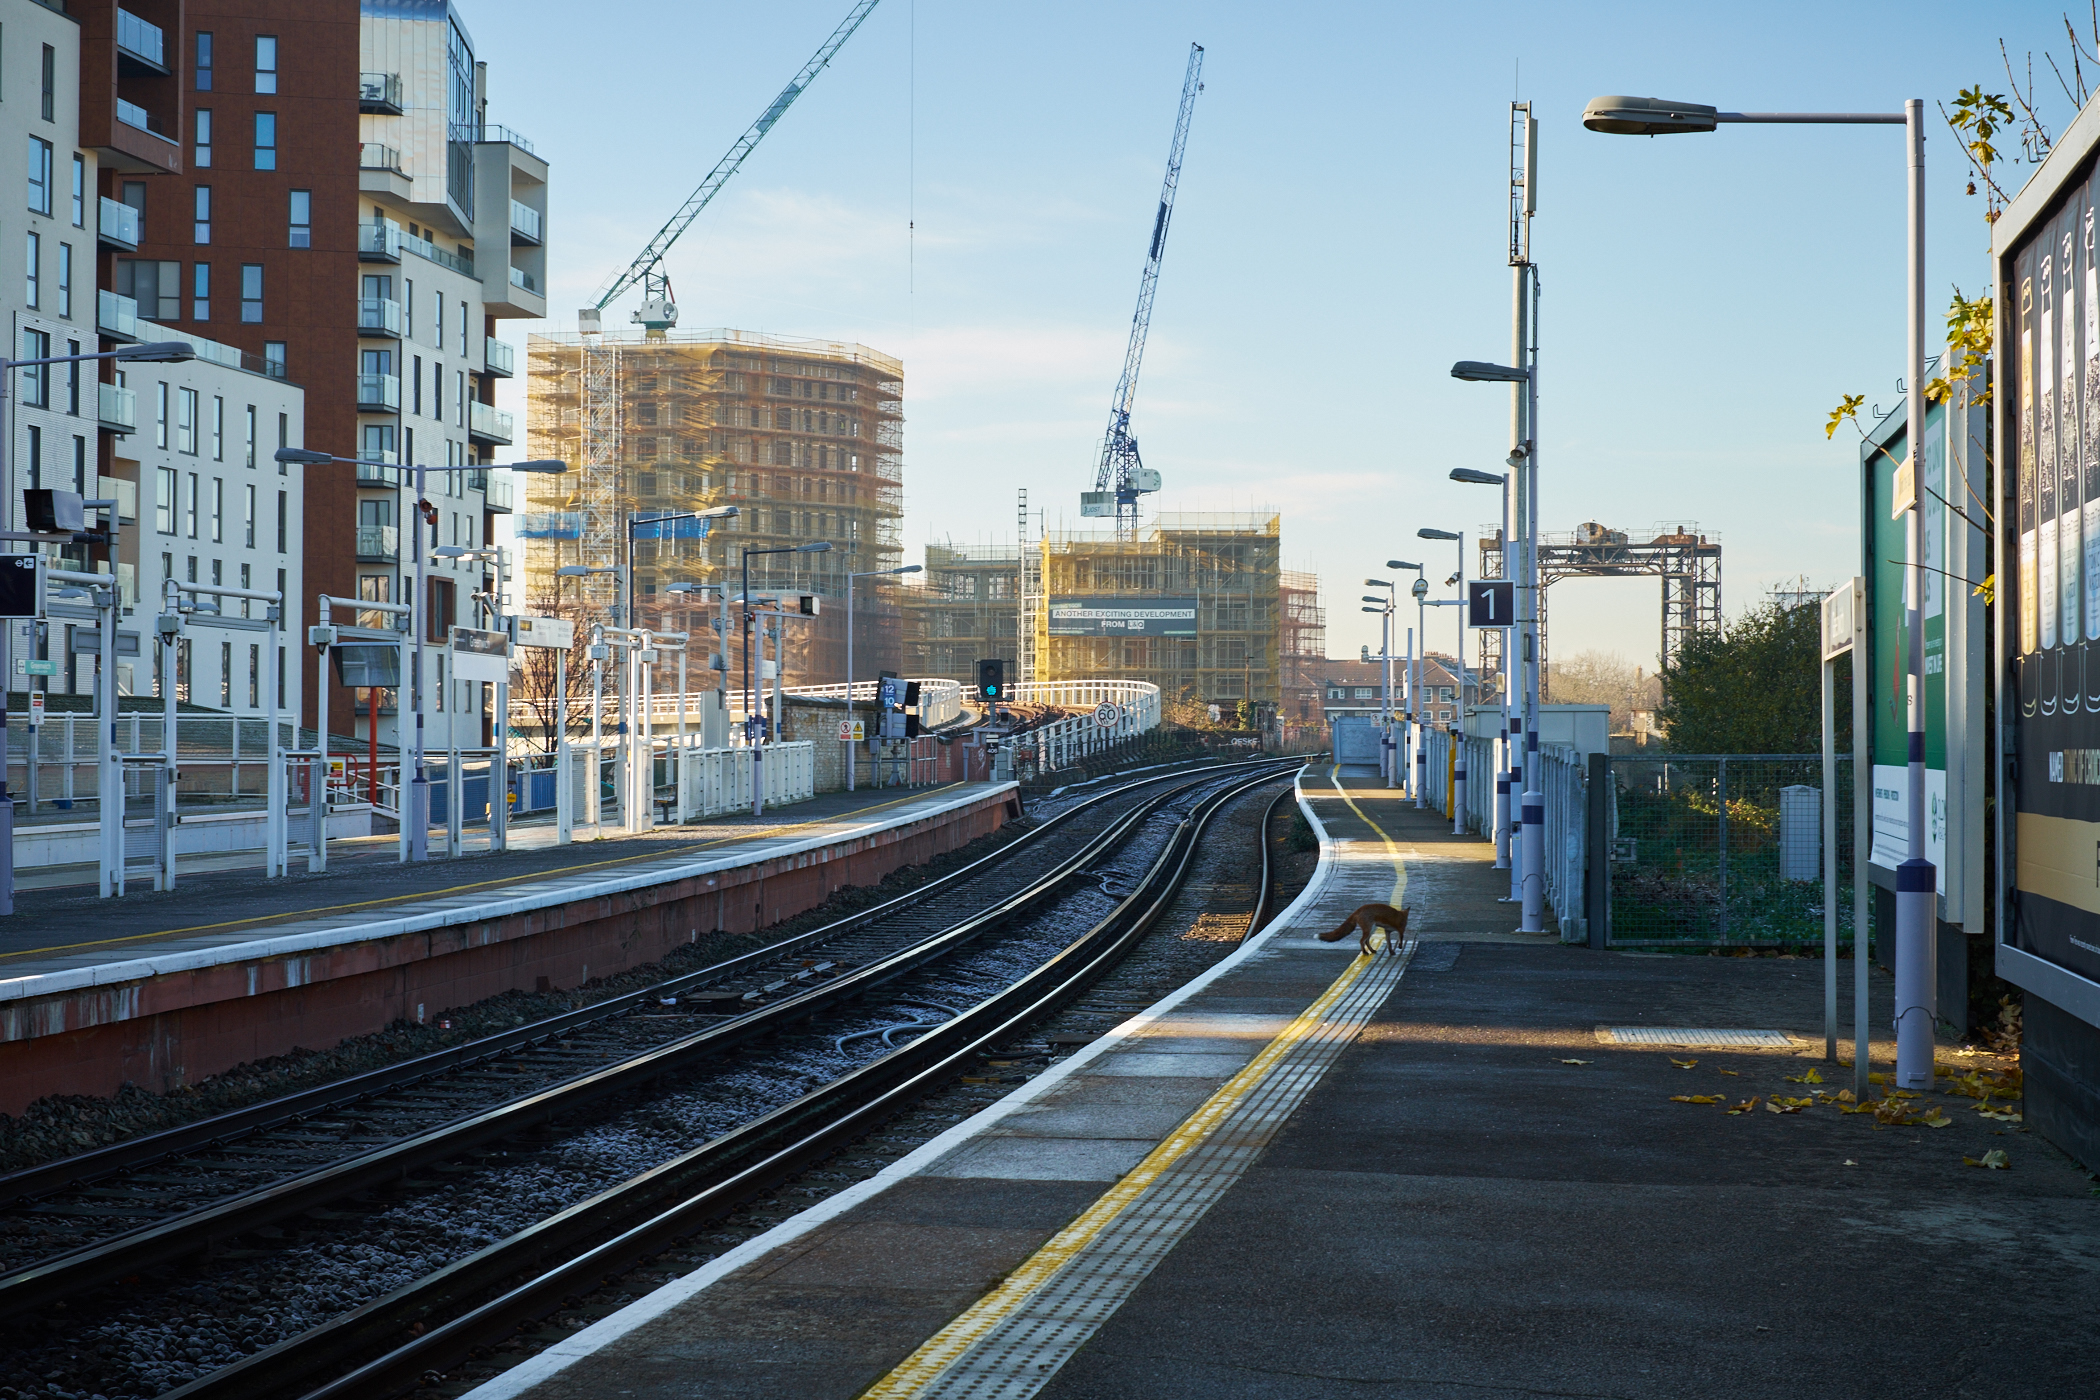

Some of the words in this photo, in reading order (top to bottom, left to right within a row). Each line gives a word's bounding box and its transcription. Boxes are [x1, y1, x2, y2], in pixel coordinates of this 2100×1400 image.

[1480, 588, 1494, 620] 1
[1101, 620, 1126, 628] FROM
[1128, 620, 1144, 629] L&Q
[884, 685, 895, 693] 12
[884, 696, 895, 705] 10
[1098, 708, 1116, 720] 60
